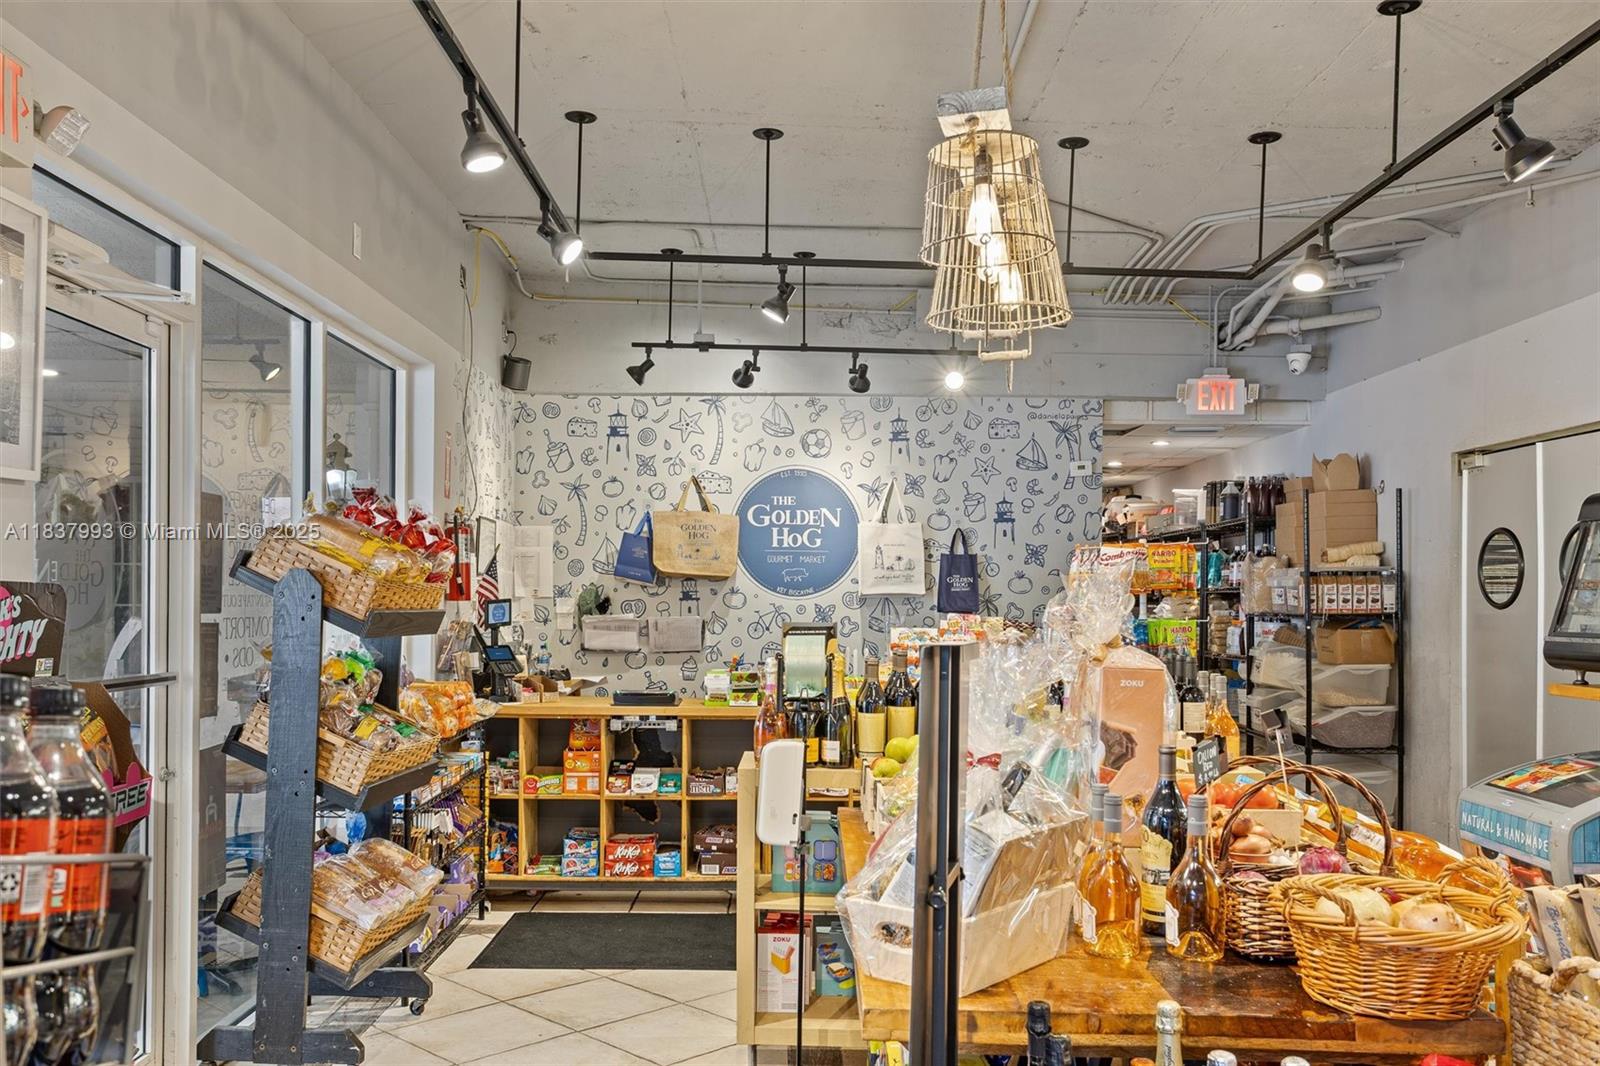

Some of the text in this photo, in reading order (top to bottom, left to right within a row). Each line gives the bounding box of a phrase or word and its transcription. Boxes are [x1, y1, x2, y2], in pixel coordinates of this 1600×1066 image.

[1198, 381, 1234, 410] EXIT
[771, 496, 797, 505] THE
[680, 523, 717, 532] GOLDEN
[688, 531, 710, 540] HOG
[1151, 550, 1177, 558] HARIBO
[767, 555, 826, 564] GOURMET MARKET
[946, 576, 974, 584] GOLDEN
[1170, 625, 1193, 634] HARIBO
[1120, 680, 1144, 688] ZOKU
[1461, 811, 1549, 853] NATURAL & HANDMADE
